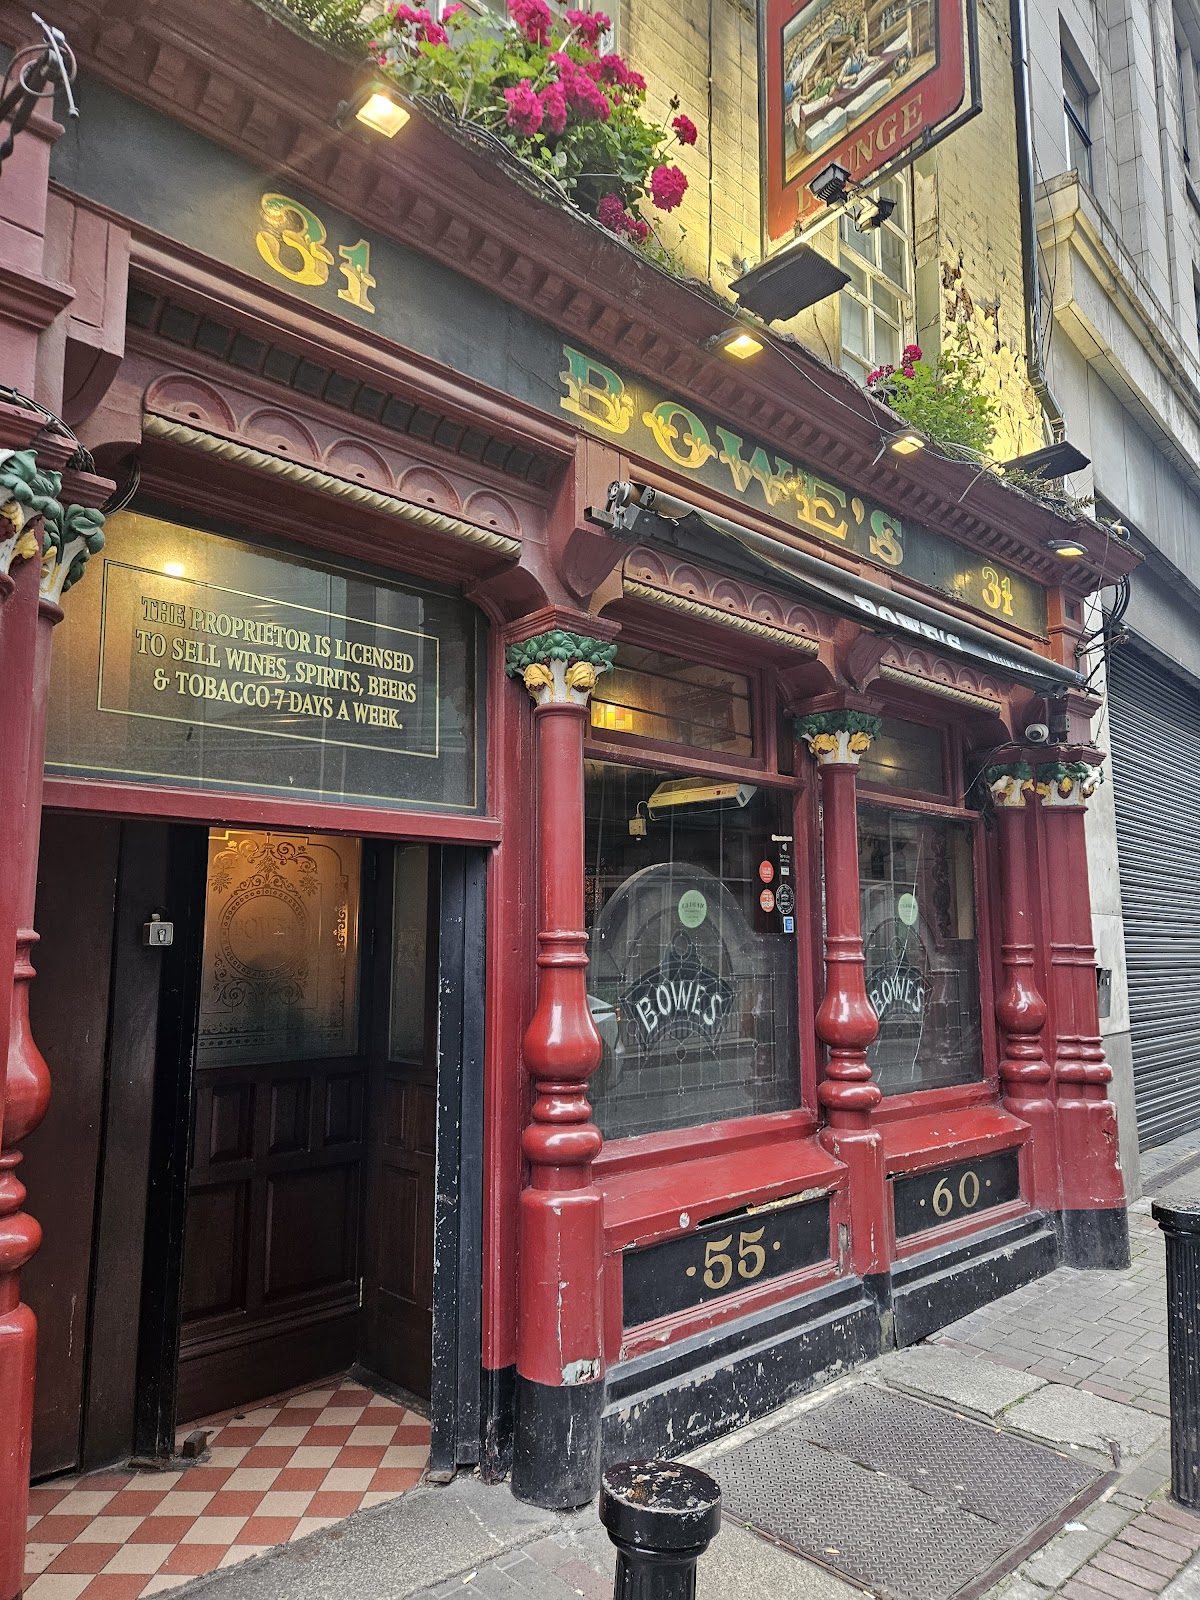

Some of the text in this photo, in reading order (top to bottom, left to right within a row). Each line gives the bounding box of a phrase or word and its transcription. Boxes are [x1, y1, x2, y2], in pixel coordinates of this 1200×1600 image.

[796, 93, 923, 214] LUNGE
[256, 192, 377, 315] 31
[560, 344, 903, 566] BOWE'S
[982, 566, 1013, 617] 31
[136, 629, 417, 703] TO SELL WINES, SPIRITS, BEERS
[141, 596, 415, 674] THE PROPRIETOR IS LICENSED
[153, 668, 404, 730] & TOBACCO 7 DAYS A WEEK.
[636, 981, 722, 1034] BOWES
[870, 976, 925, 1020] BOWES
